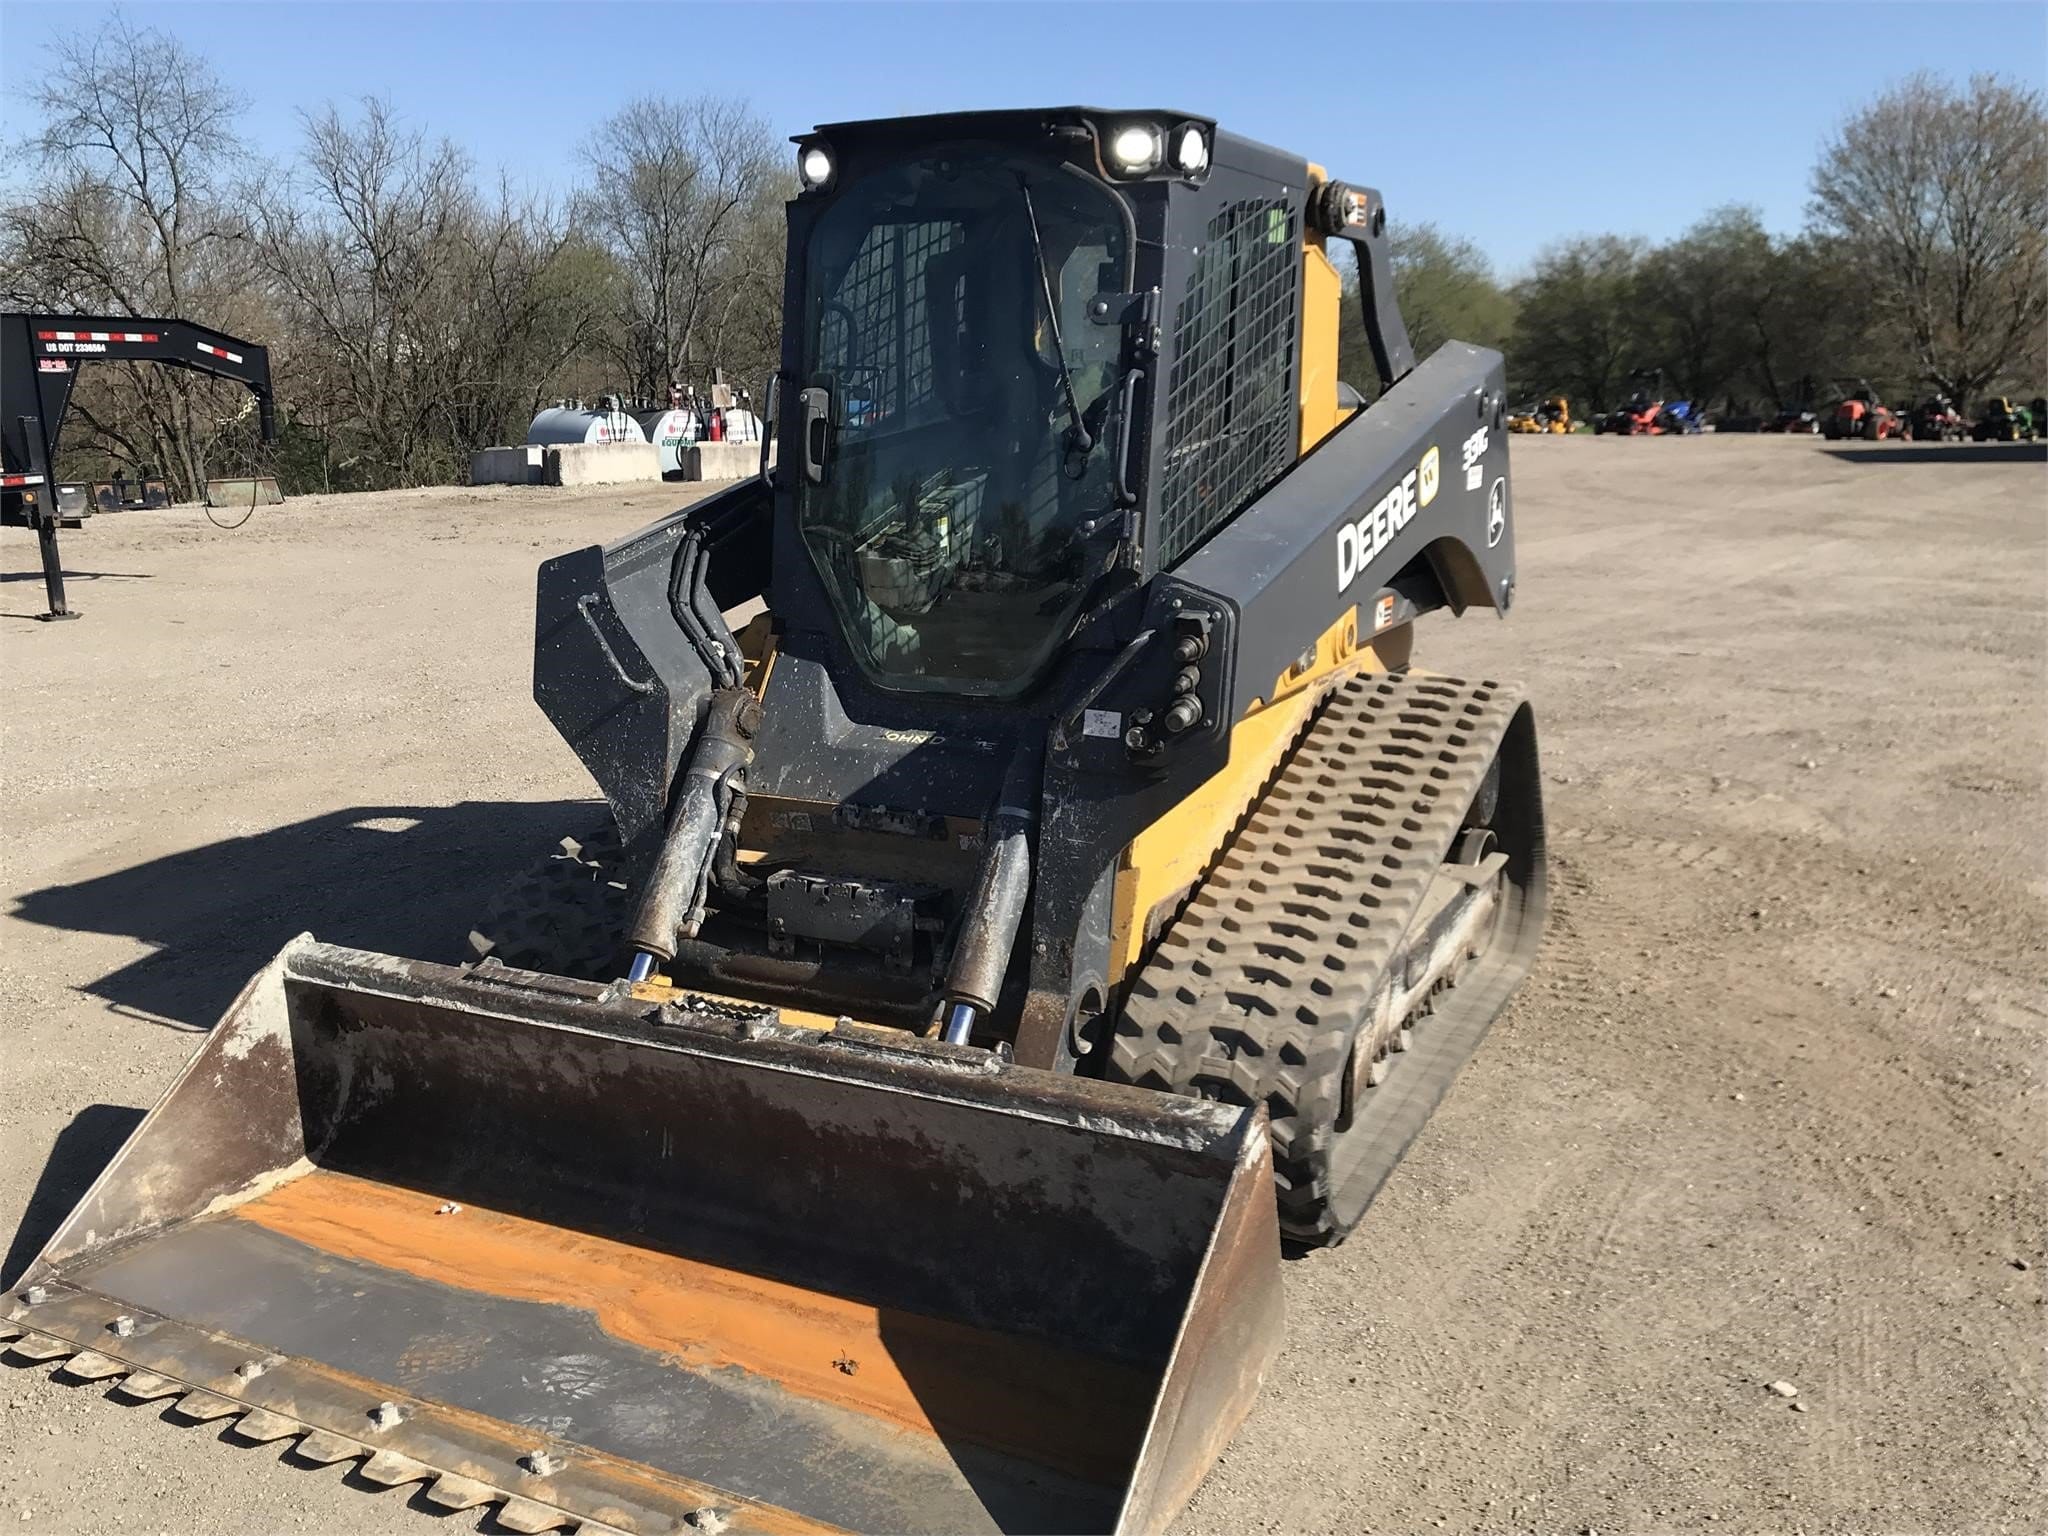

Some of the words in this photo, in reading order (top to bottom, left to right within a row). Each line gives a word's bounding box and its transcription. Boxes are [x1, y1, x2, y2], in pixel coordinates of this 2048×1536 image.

[46, 343, 57, 352] US
[58, 343, 73, 352] DOT
[1337, 468, 1417, 593] DEERE
